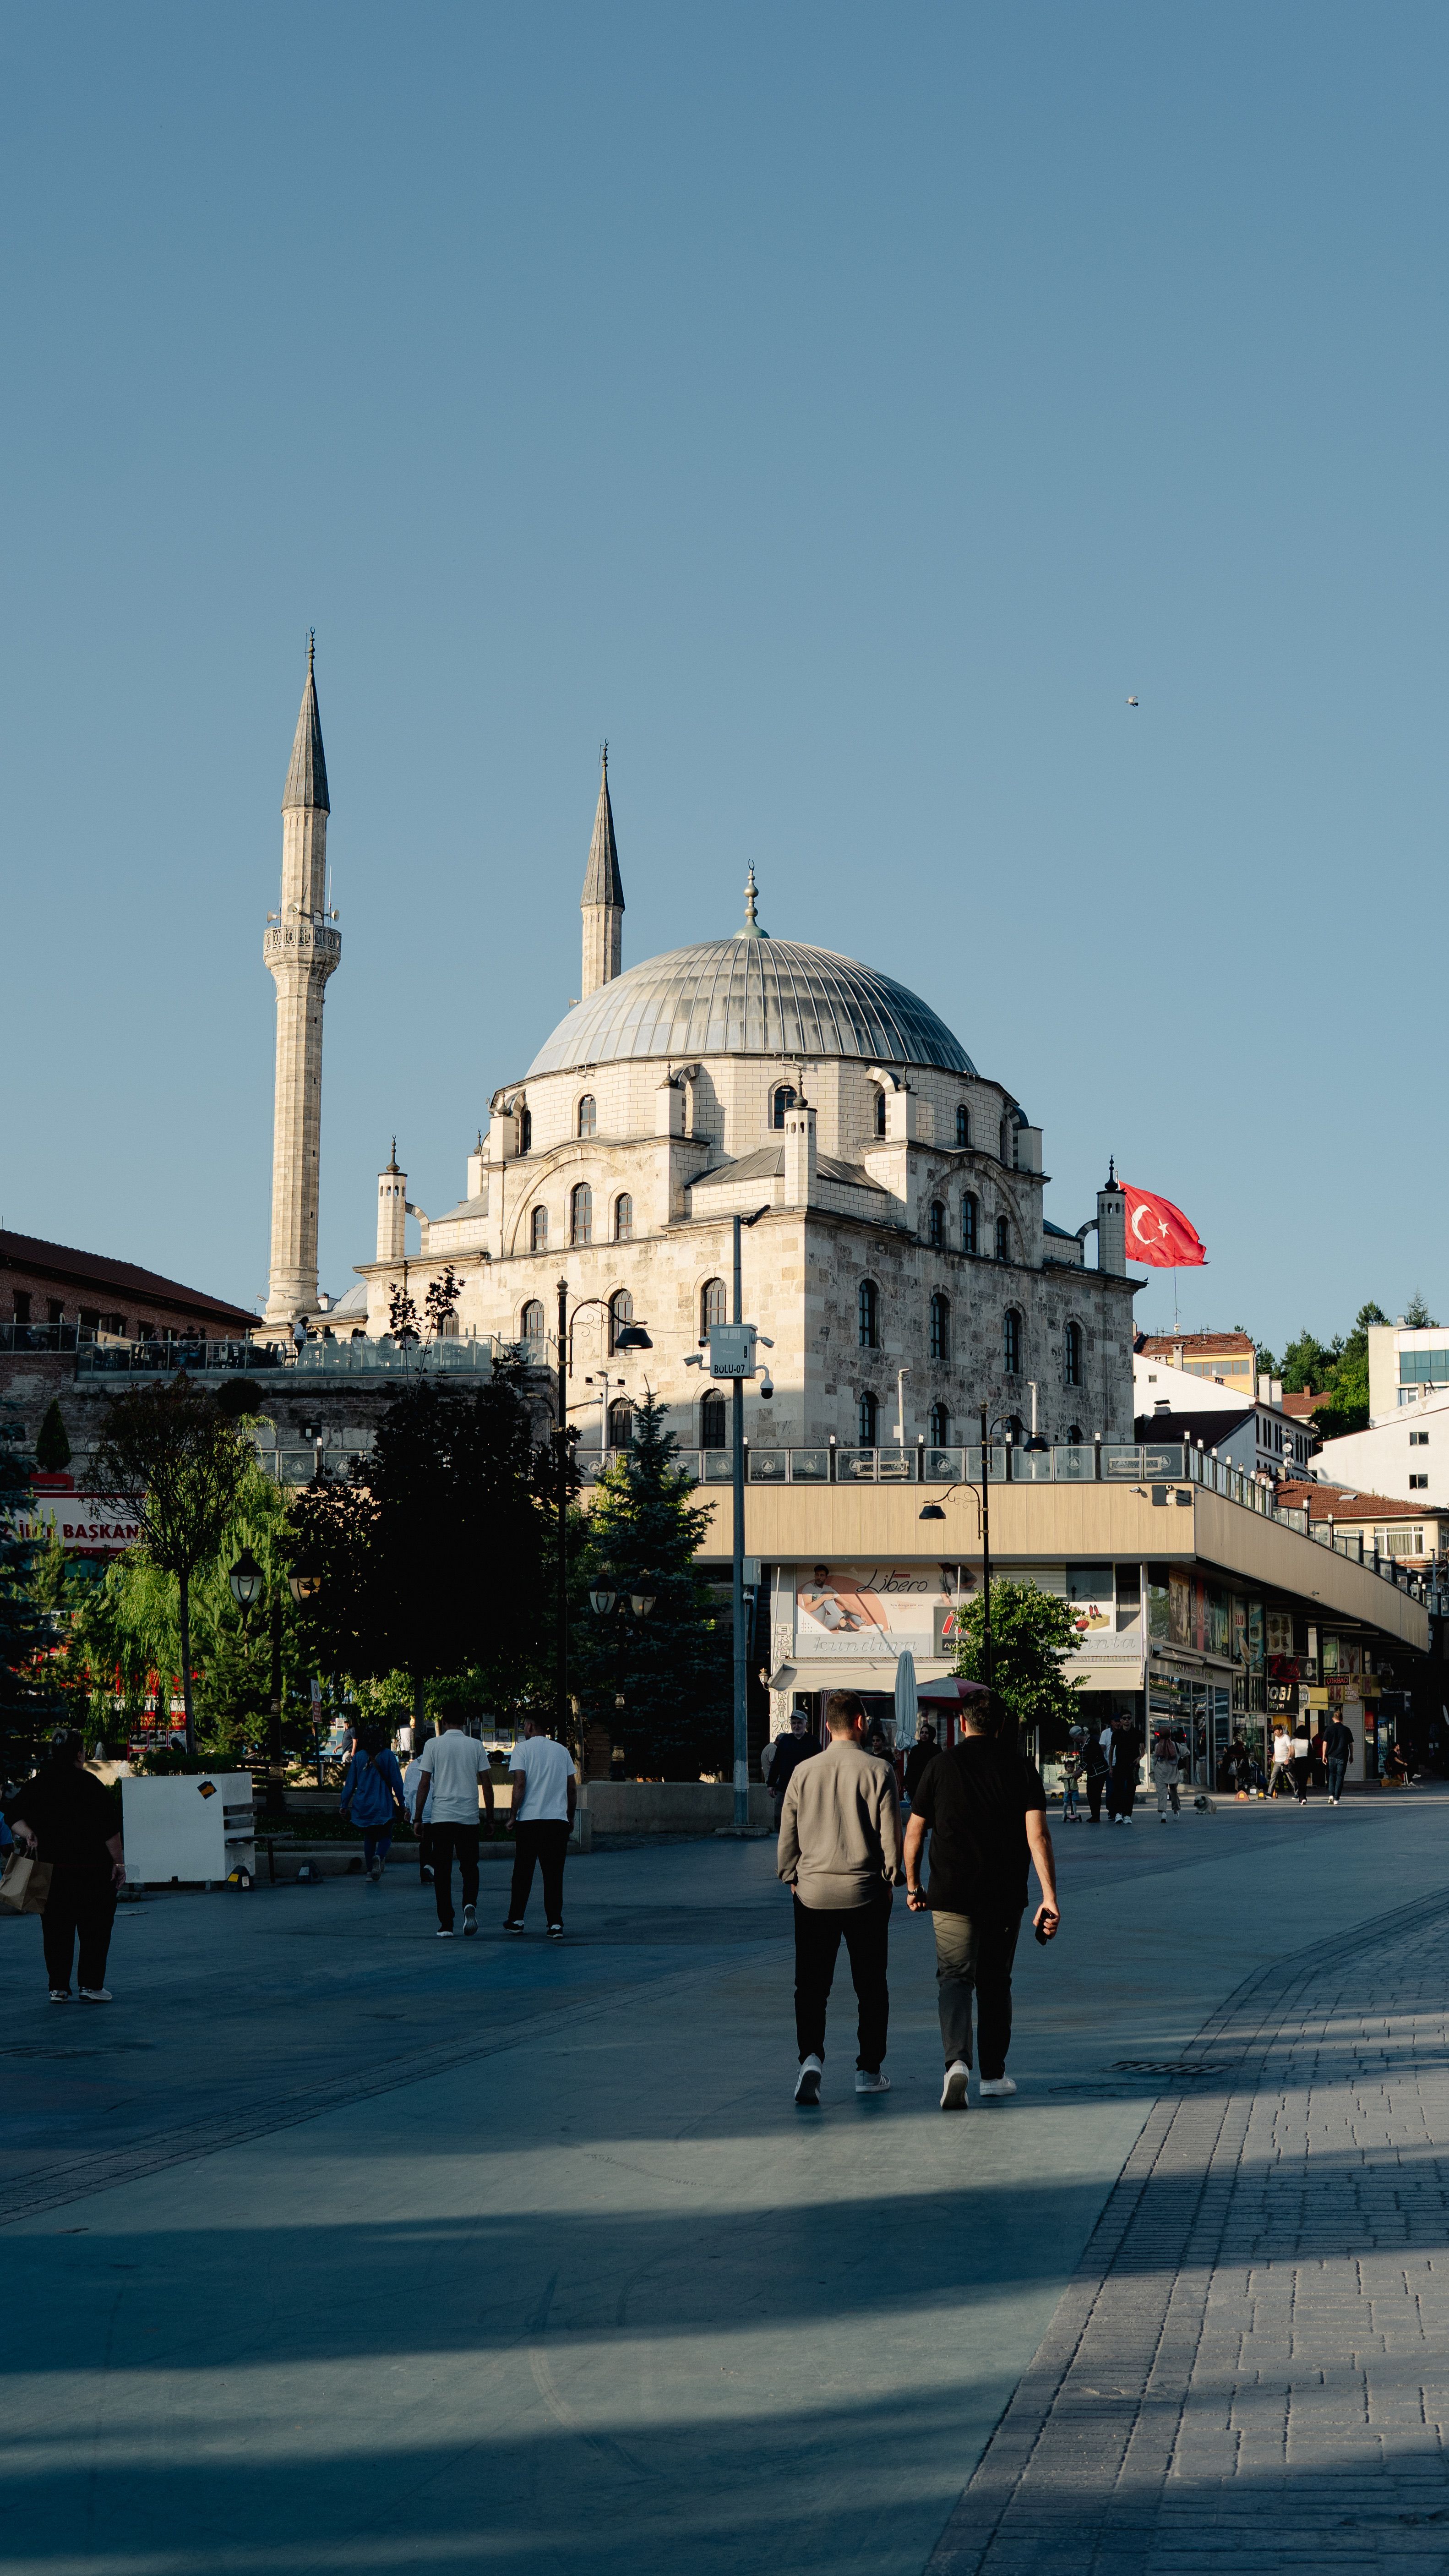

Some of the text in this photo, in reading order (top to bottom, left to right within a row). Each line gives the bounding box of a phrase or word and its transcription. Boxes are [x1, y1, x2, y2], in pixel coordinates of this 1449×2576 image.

[714, 1364, 745, 1374] BOLU-07
[63, 1524, 140, 1542] BAŞKAN
[856, 1569, 928, 1594] Libero
[777, 1626, 790, 1664] ERKE
[812, 1637, 918, 1652] kundura
[1081, 1636, 1136, 1650] anta
